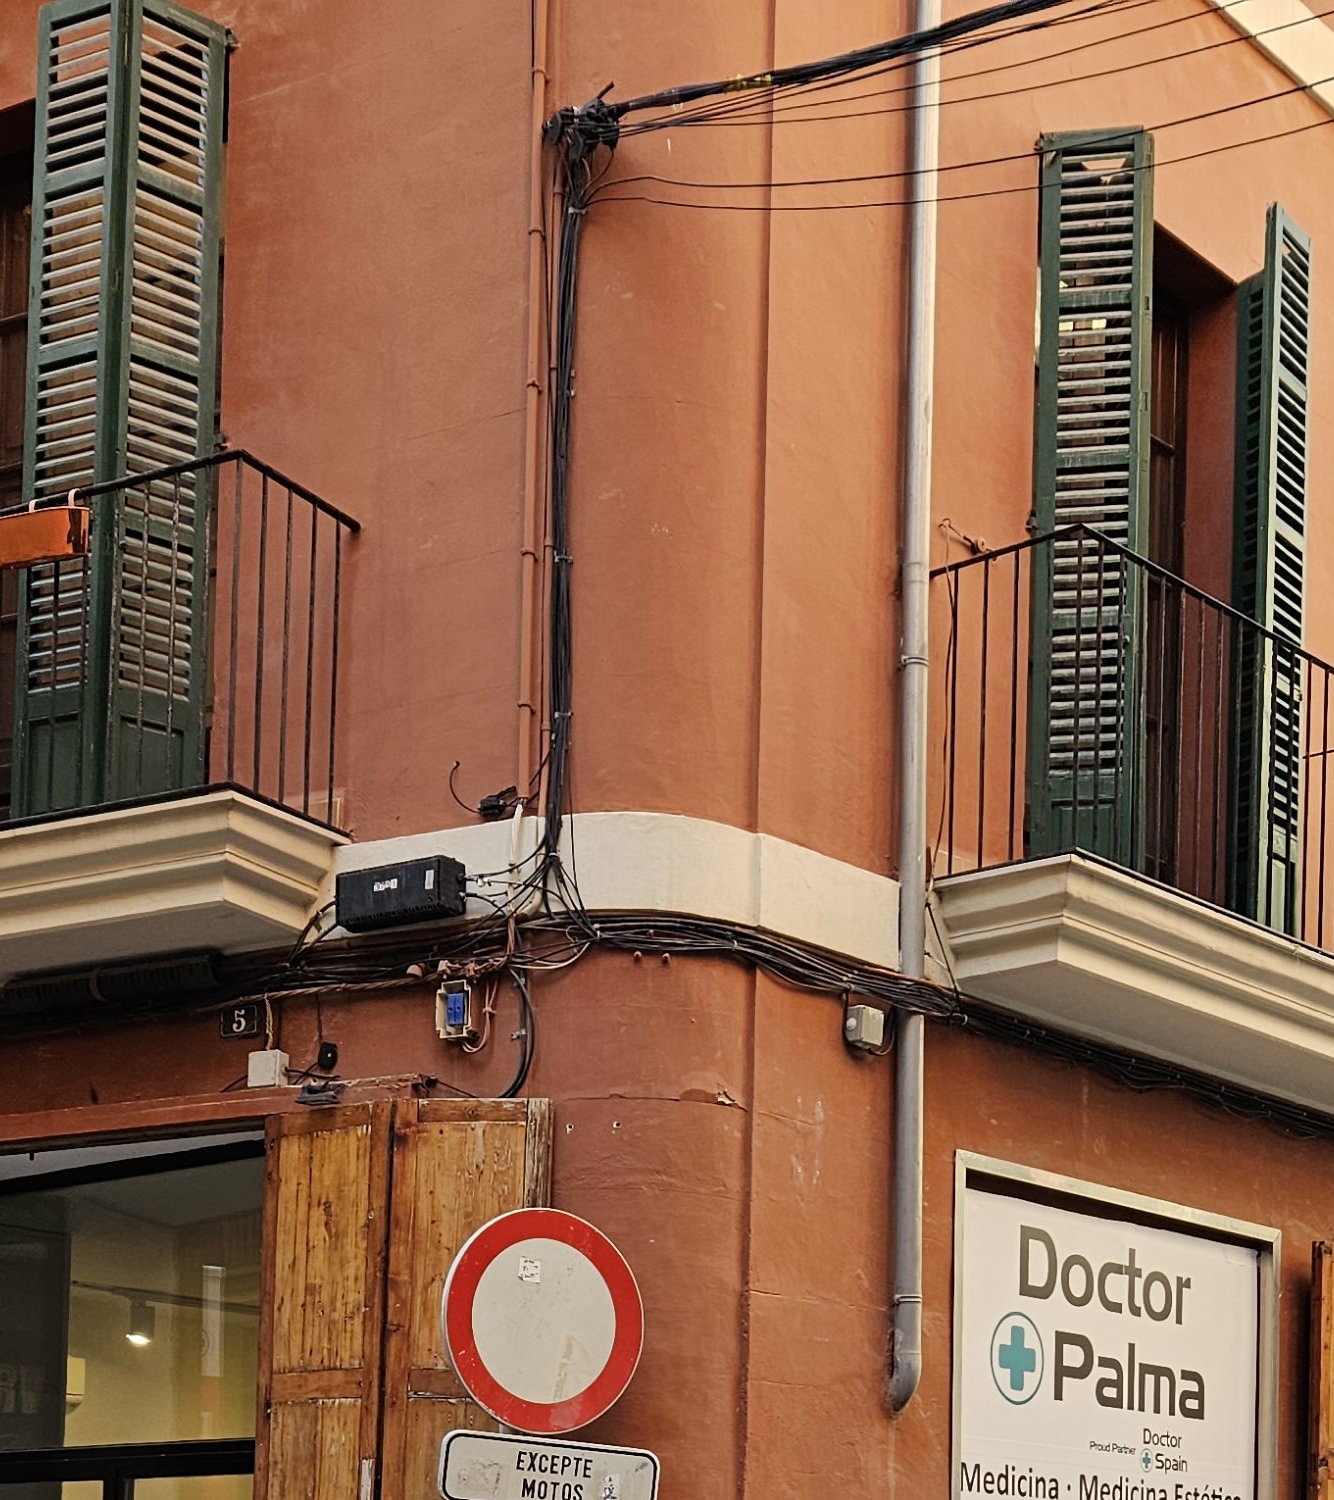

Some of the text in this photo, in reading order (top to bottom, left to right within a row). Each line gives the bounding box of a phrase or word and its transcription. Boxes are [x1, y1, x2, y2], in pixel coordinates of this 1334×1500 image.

[232, 1009, 246, 1032] 5
[1019, 1224, 1191, 1325] Doctor
[1054, 1330, 1205, 1420] Palma
[1142, 1428, 1182, 1448] Doctor
[516, 1450, 593, 1478] EXCEPTE
[1155, 1453, 1188, 1474] Spain
[960, 1462, 1059, 1500] Medicina
